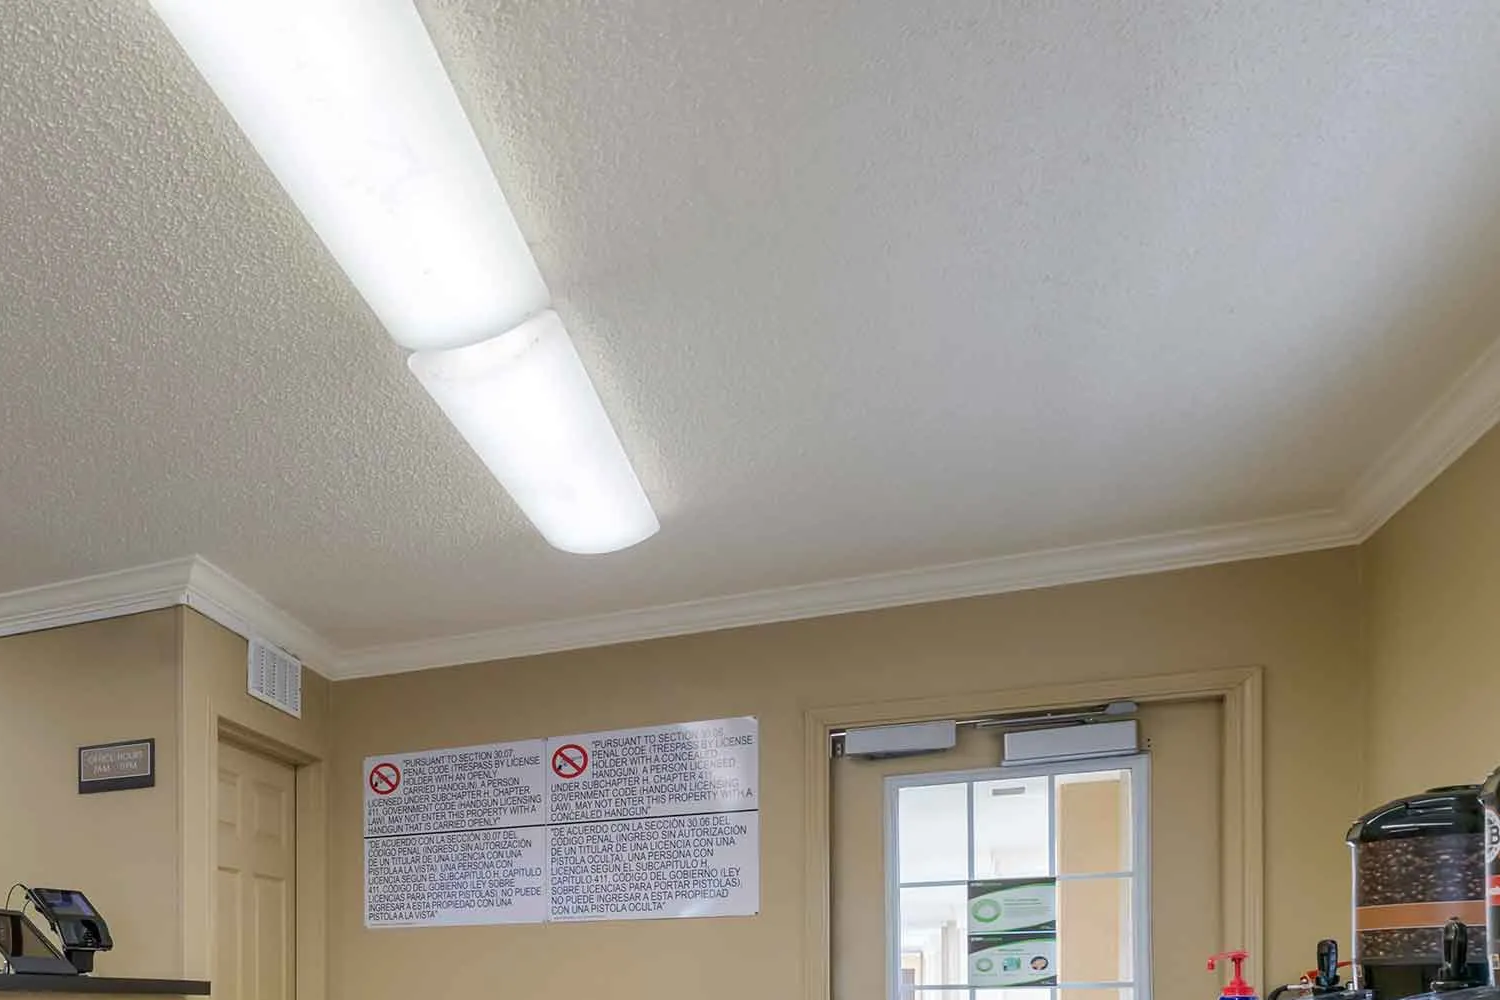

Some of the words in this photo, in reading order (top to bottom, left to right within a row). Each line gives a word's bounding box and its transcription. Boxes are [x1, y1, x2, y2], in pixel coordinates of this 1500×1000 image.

[644, 734, 654, 744] TO
[592, 748, 619, 758] PENAL
[621, 745, 645, 756] CODE
[701, 739, 714, 749] BY
[445, 754, 457, 763] TO
[459, 751, 491, 762] SECTION
[592, 757, 627, 769] HOLDER
[630, 755, 651, 765] WITH
[654, 754, 659, 763] A
[403, 766, 426, 776] PENAL
[428, 764, 448, 774] CODE
[494, 758, 504, 768] BY
[506, 755, 539, 767] LICENSE
[643, 765, 647, 774] A
[650, 762, 686, 774] PERSON
[403, 775, 432, 785] HOLDER
[435, 773, 452, 783] WITH
[455, 772, 465, 781] AN
[467, 769, 497, 780] OPENLY
[551, 781, 580, 792] UNDER
[582, 777, 639, 789] SUBCHAPTER
[653, 772, 695, 784] CHAPTER
[403, 784, 434, 795] CARRIED
[480, 780, 485, 788] A
[486, 777, 519, 787] PERSON
[550, 789, 610, 801] GOVERNMENT
[612, 786, 636, 797] CODE
[367, 796, 402, 807] LICENSED
[403, 794, 429, 804] UNDER
[431, 789, 481, 802] SUBCHAPTER
[493, 785, 530, 797] CHAPTER
[575, 800, 592, 809] MAY
[595, 798, 612, 808] NOT
[615, 796, 644, 806] ENTER
[646, 794, 665, 804] THIS
[668, 790, 716, 803] PROPERTY
[746, 787, 752, 797] A
[382, 803, 432, 815] GOVERNMENT
[434, 801, 456, 811] CODE
[500, 794, 541, 805] LICENSING
[388, 815, 402, 823] MAY
[404, 813, 420, 822] NOT
[421, 811, 445, 821] ENTER
[448, 810, 464, 819] THIS
[466, 806, 507, 817] PROPERTY
[509, 805, 529, 814] WITH
[530, 804, 536, 812] A
[550, 809, 602, 821] CONCEALED
[368, 824, 402, 834] HANDGUN
[405, 822, 422, 831] THAT
[424, 822, 430, 830] IS
[432, 819, 465, 829] CARRIED
[566, 824, 608, 835] ACUERDO
[611, 823, 629, 832] CON
[632, 822, 643, 831] LA
[712, 816, 730, 826] DEL
[381, 837, 416, 847] ACUERDO
[418, 836, 434, 845] CON
[436, 835, 444, 843] LA
[502, 830, 516, 839] DEL
[586, 834, 613, 843] PENAL
[661, 830, 676, 839] SIN
[678, 824, 746, 838] AUTORIZACIÓN
[398, 846, 419, 855] PENAL
[460, 843, 472, 851] SIN
[551, 847, 562, 855] DE
[564, 846, 576, 855] UN
[578, 844, 613, 854] TITULAR
[616, 843, 626, 852] DE
[630, 842, 648, 851] UNA
[650, 839, 690, 850] LICENCIA
[693, 838, 713, 848] CON
[715, 837, 735, 847] UNA
[368, 858, 378, 866] DE
[379, 857, 389, 865] UN
[391, 855, 420, 865] TITULAR
[422, 855, 432, 863] DE
[434, 853, 449, 862] UNA
[451, 851, 485, 861] LICENCIA
[487, 850, 503, 859] CON
[505, 849, 521, 858] UNA
[551, 855, 584, 865] PISTOLA
[627, 852, 646, 861] UNA
[648, 849, 691, 860] PERSONA
[693, 848, 713, 858] CON
[368, 866, 397, 875] PISTOLA
[398, 865, 402, 873] A
[404, 865, 412, 873] LA
[441, 863, 456, 871] UNA
[458, 860, 494, 870] PERSONA
[496, 859, 512, 868] CON
[551, 864, 588, 875] LICENCIA
[623, 862, 633, 872] EL
[368, 875, 400, 884] LICENCIA
[428, 873, 437, 881] EL
[650, 871, 666, 881] DEL
[669, 869, 717, 880] GOBIERNO
[412, 883, 426, 891] DEL
[428, 881, 467, 891] GOBIERNO
[488, 879, 514, 888] SOBRE
[551, 885, 579, 894] SOBRE
[582, 883, 626, 893] LICENCIAS
[629, 882, 651, 892] PARA
[654, 880, 689, 891] PORTAR
[369, 893, 404, 902] LICENCIAS
[406, 892, 425, 901] PARA
[427, 891, 456, 900] PORTAR
[501, 889, 512, 897] NO
[514, 888, 540, 896] PUEDE
[551, 895, 563, 904] NO
[566, 894, 594, 903] PUEDE
[596, 892, 640, 902] INGRESAR
[643, 892, 648, 901] A
[651, 891, 672, 901] ESTA
[675, 889, 728, 900] PROPIEDAD
[369, 902, 404, 911] INGRESAR
[406, 902, 410, 910] A
[412, 901, 430, 910] ESTA
[431, 899, 475, 909] PROPIEDAD
[476, 899, 493, 907] CON
[495, 898, 512, 907] UNA
[551, 905, 569, 913] CON
[571, 904, 589, 913] UNA
[591, 903, 626, 912] PISTOLA
[368, 912, 397, 920] PISTOLA
[405, 911, 413, 919] LA
